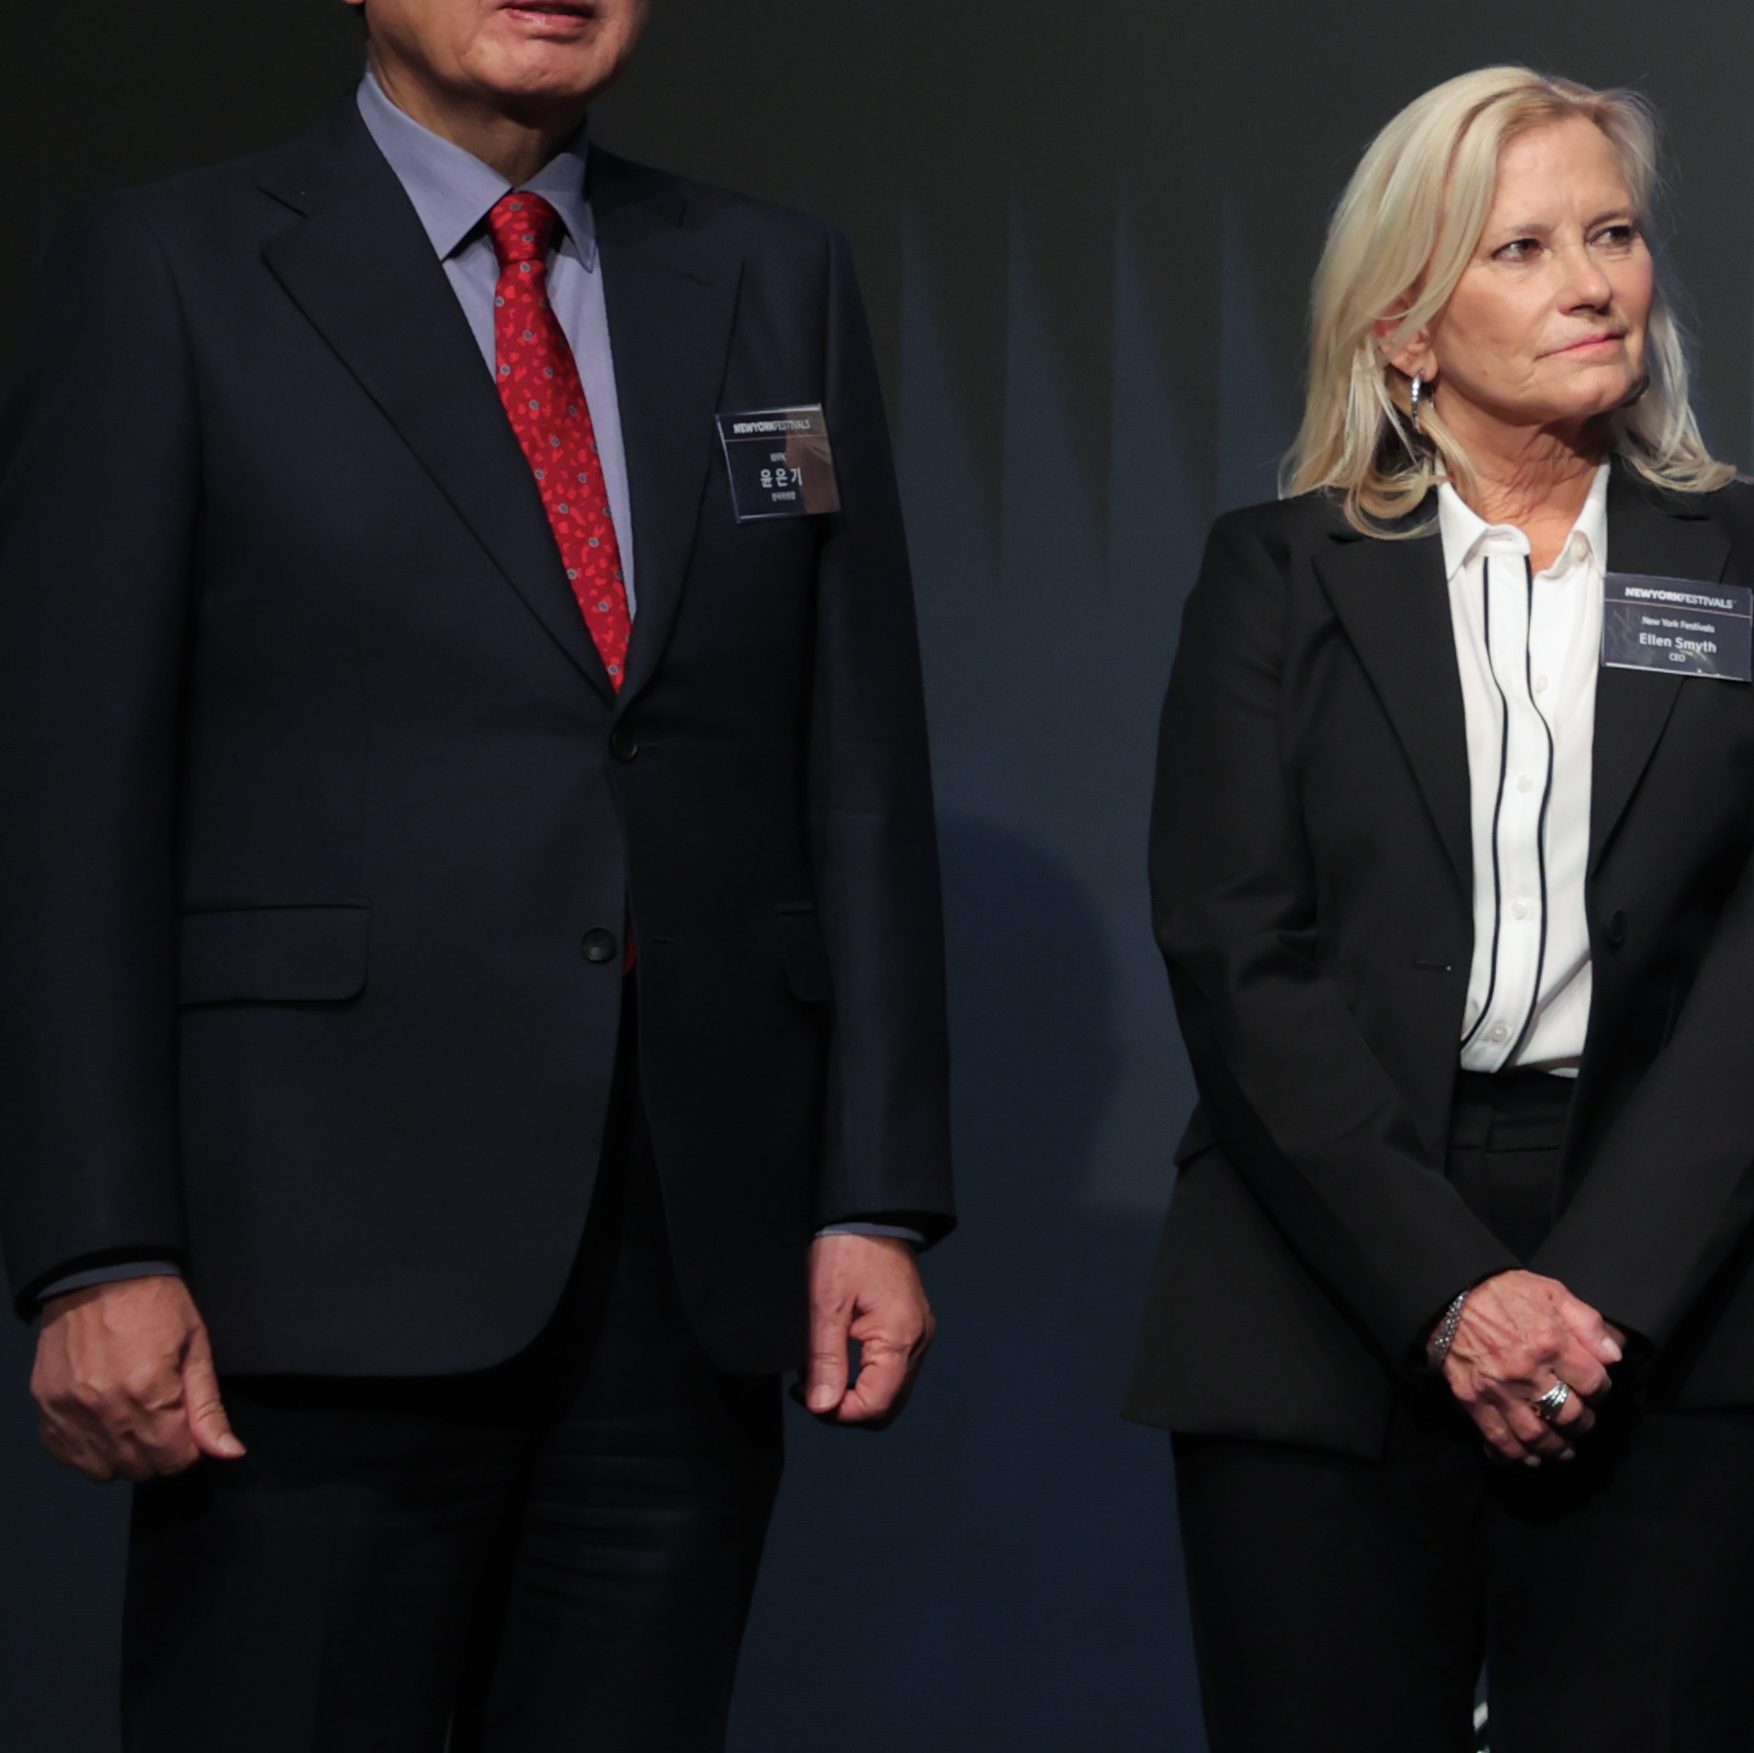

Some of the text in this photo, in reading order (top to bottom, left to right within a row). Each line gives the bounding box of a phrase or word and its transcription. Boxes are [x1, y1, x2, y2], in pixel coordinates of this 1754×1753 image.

[1642, 616, 1715, 633] New York Festivals
[1639, 633, 1717, 654] Ellen Smyth
[1668, 652, 1686, 663] CEO
